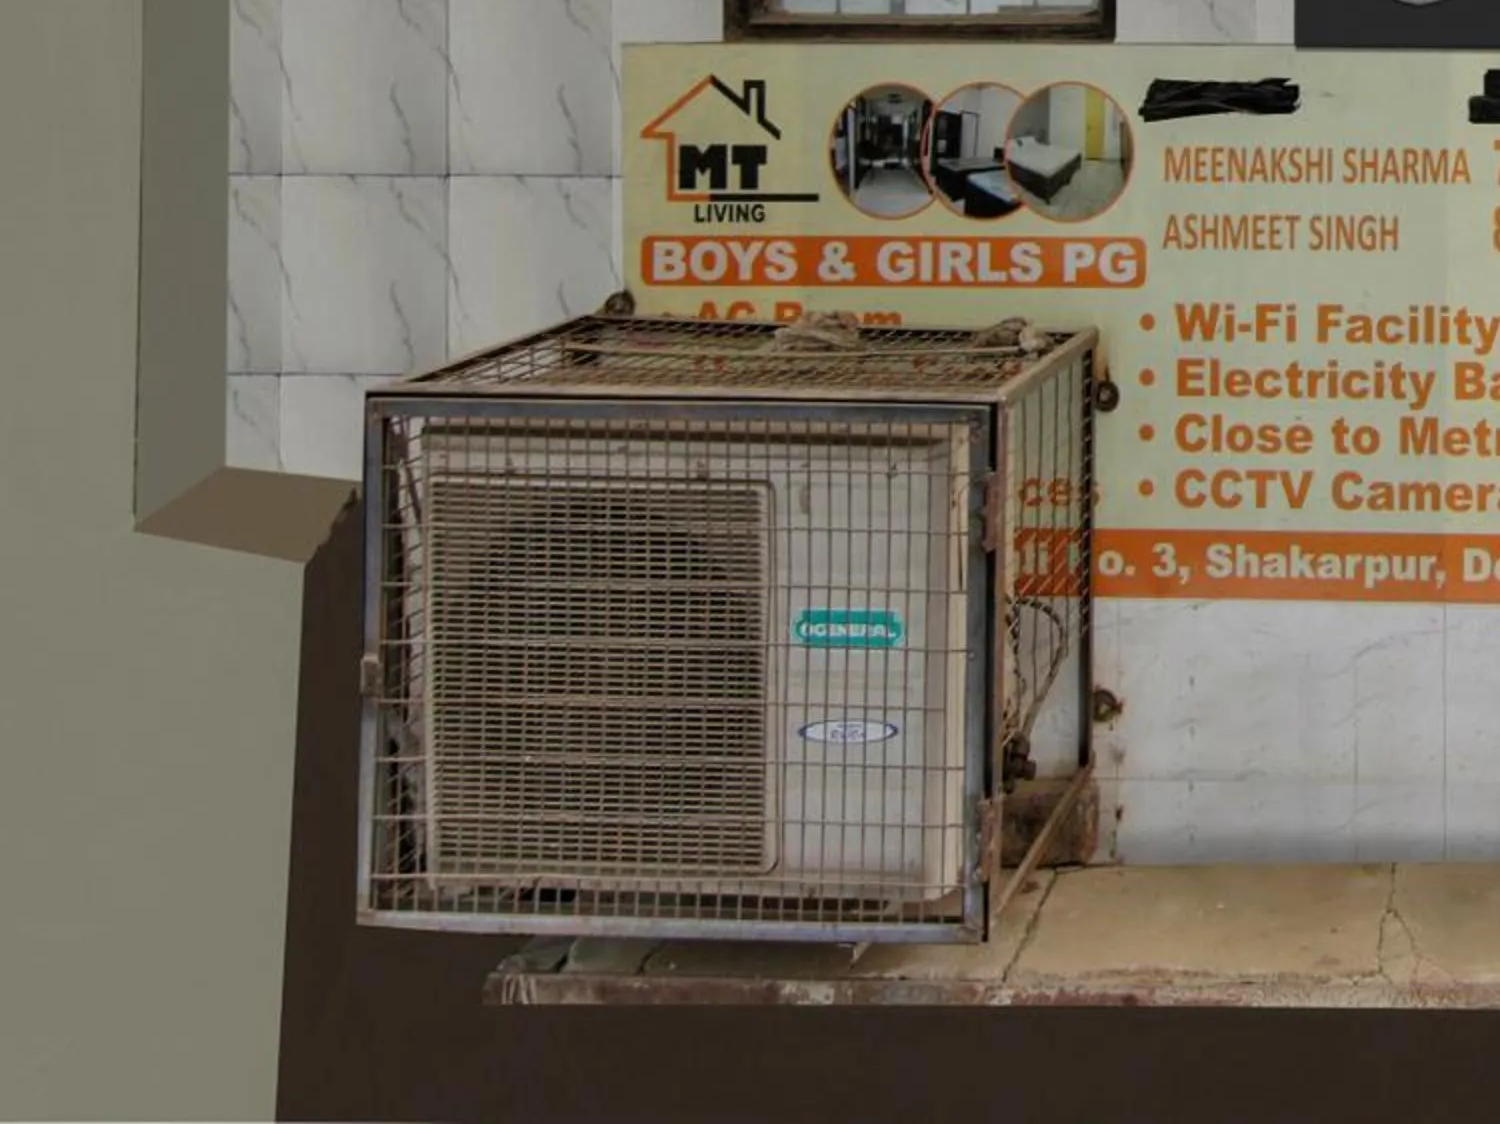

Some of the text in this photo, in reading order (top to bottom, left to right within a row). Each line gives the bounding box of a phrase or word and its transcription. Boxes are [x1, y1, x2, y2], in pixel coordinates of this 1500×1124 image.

[678, 144, 767, 190] MT
[1164, 146, 1334, 185] MEENAKSHI
[1342, 147, 1472, 185] SHARMA
[694, 204, 766, 223] LIVING
[1162, 213, 1301, 252] ASHMEET
[1309, 214, 1400, 252] SINGH
[651, 240, 1137, 284] BOYS & GIRLS PG
[1175, 303, 1297, 345] Wi-Fi
[1175, 358, 1435, 411] Electricity
[1174, 413, 1314, 455] Close
[1332, 419, 1379, 456] to
[1175, 470, 1314, 510] CCTV
[1152, 543, 1190, 585] 3,
[1205, 544, 1446, 588] Shakarpur,
